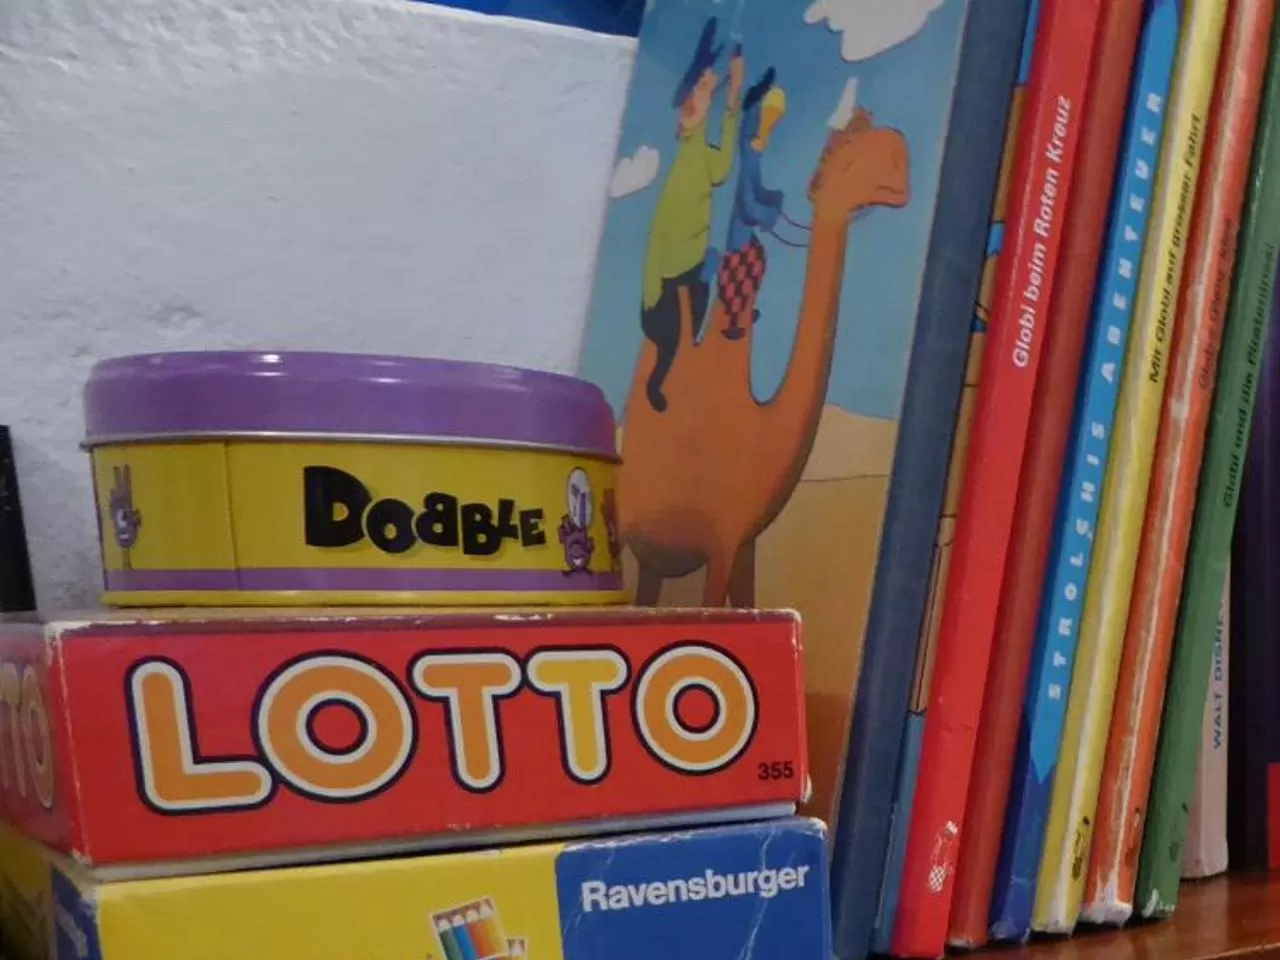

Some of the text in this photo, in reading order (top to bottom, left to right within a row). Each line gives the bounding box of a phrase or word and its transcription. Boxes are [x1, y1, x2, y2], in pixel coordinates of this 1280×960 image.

[1012, 95, 1072, 368] Globi beim Roten Kreuz
[1100, 92, 1162, 383] ABENTEUER
[1155, 290, 1176, 342] Globi
[1149, 347, 1163, 383] Mit
[125, 639, 759, 815] LOTTO
[1213, 693, 1224, 749] WALT
[757, 761, 794, 780] 355
[581, 864, 811, 912] Ravensburger
